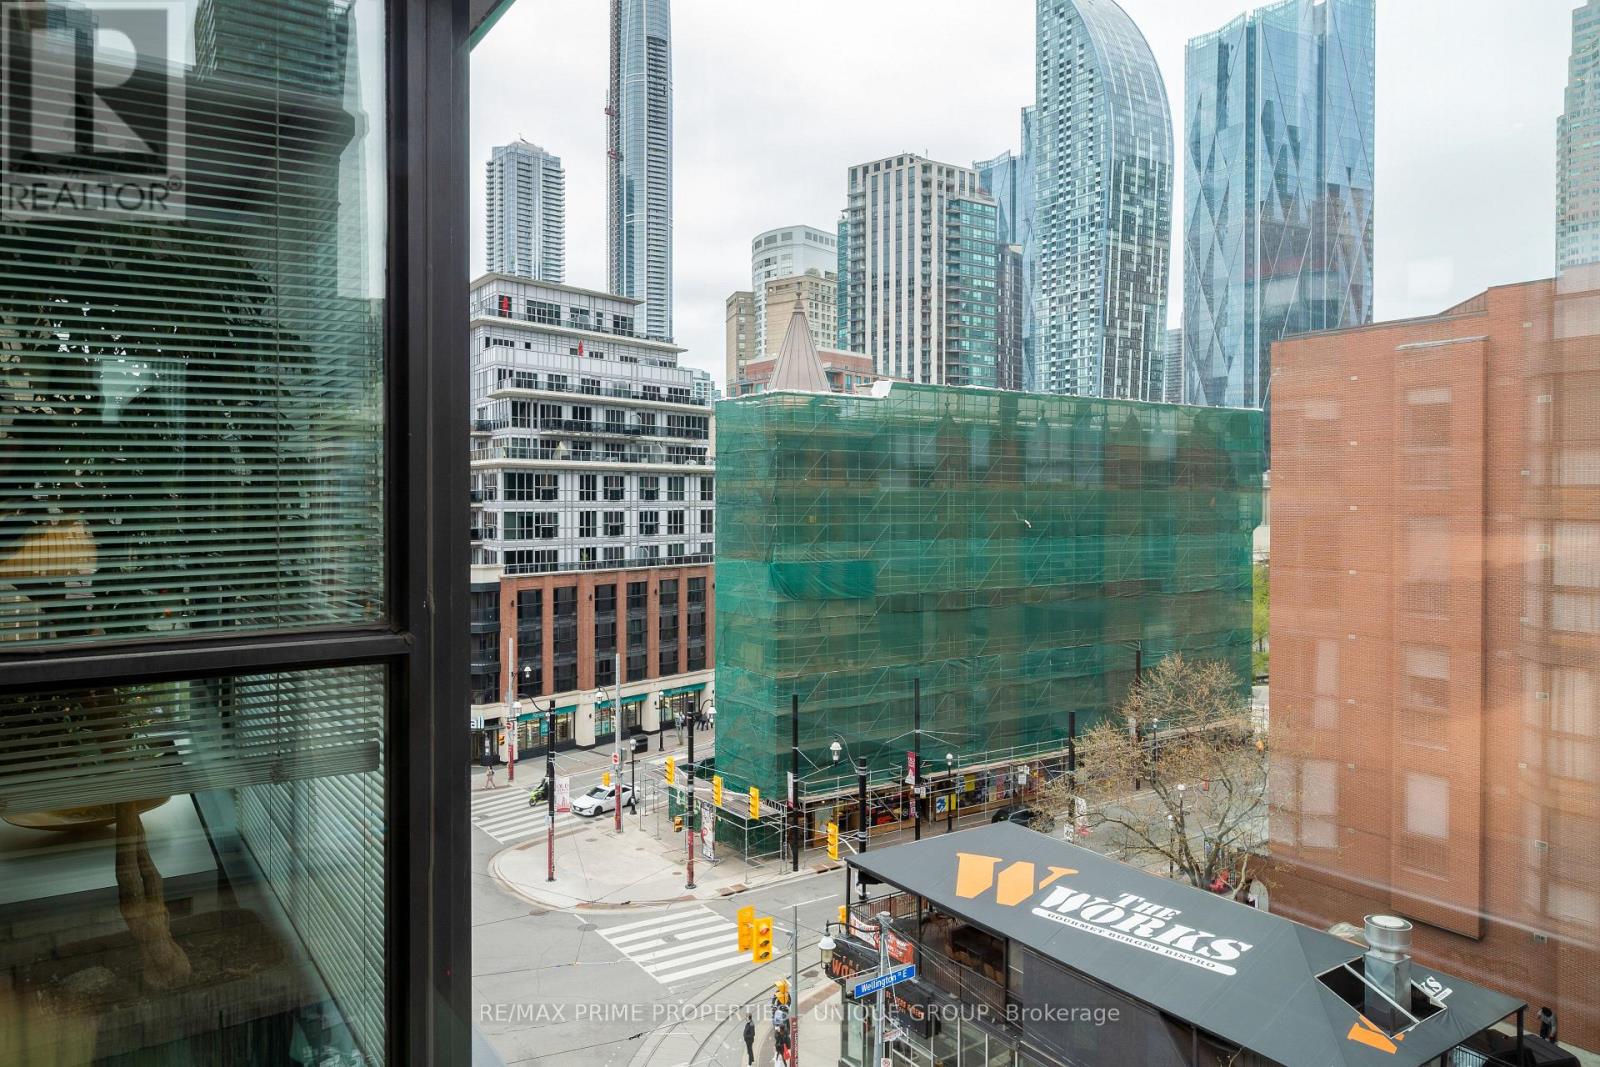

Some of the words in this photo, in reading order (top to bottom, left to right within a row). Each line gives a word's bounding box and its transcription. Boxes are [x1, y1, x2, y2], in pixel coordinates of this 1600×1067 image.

[1040, 885, 1254, 961] WORKS
[1118, 892, 1182, 920] THE
[1047, 913, 1106, 934] GOURMET
[1108, 932, 1160, 951] BURGER
[1164, 949, 1216, 969] BISTRO
[861, 974, 897, 993] Wellington
[902, 969, 908, 978] E
